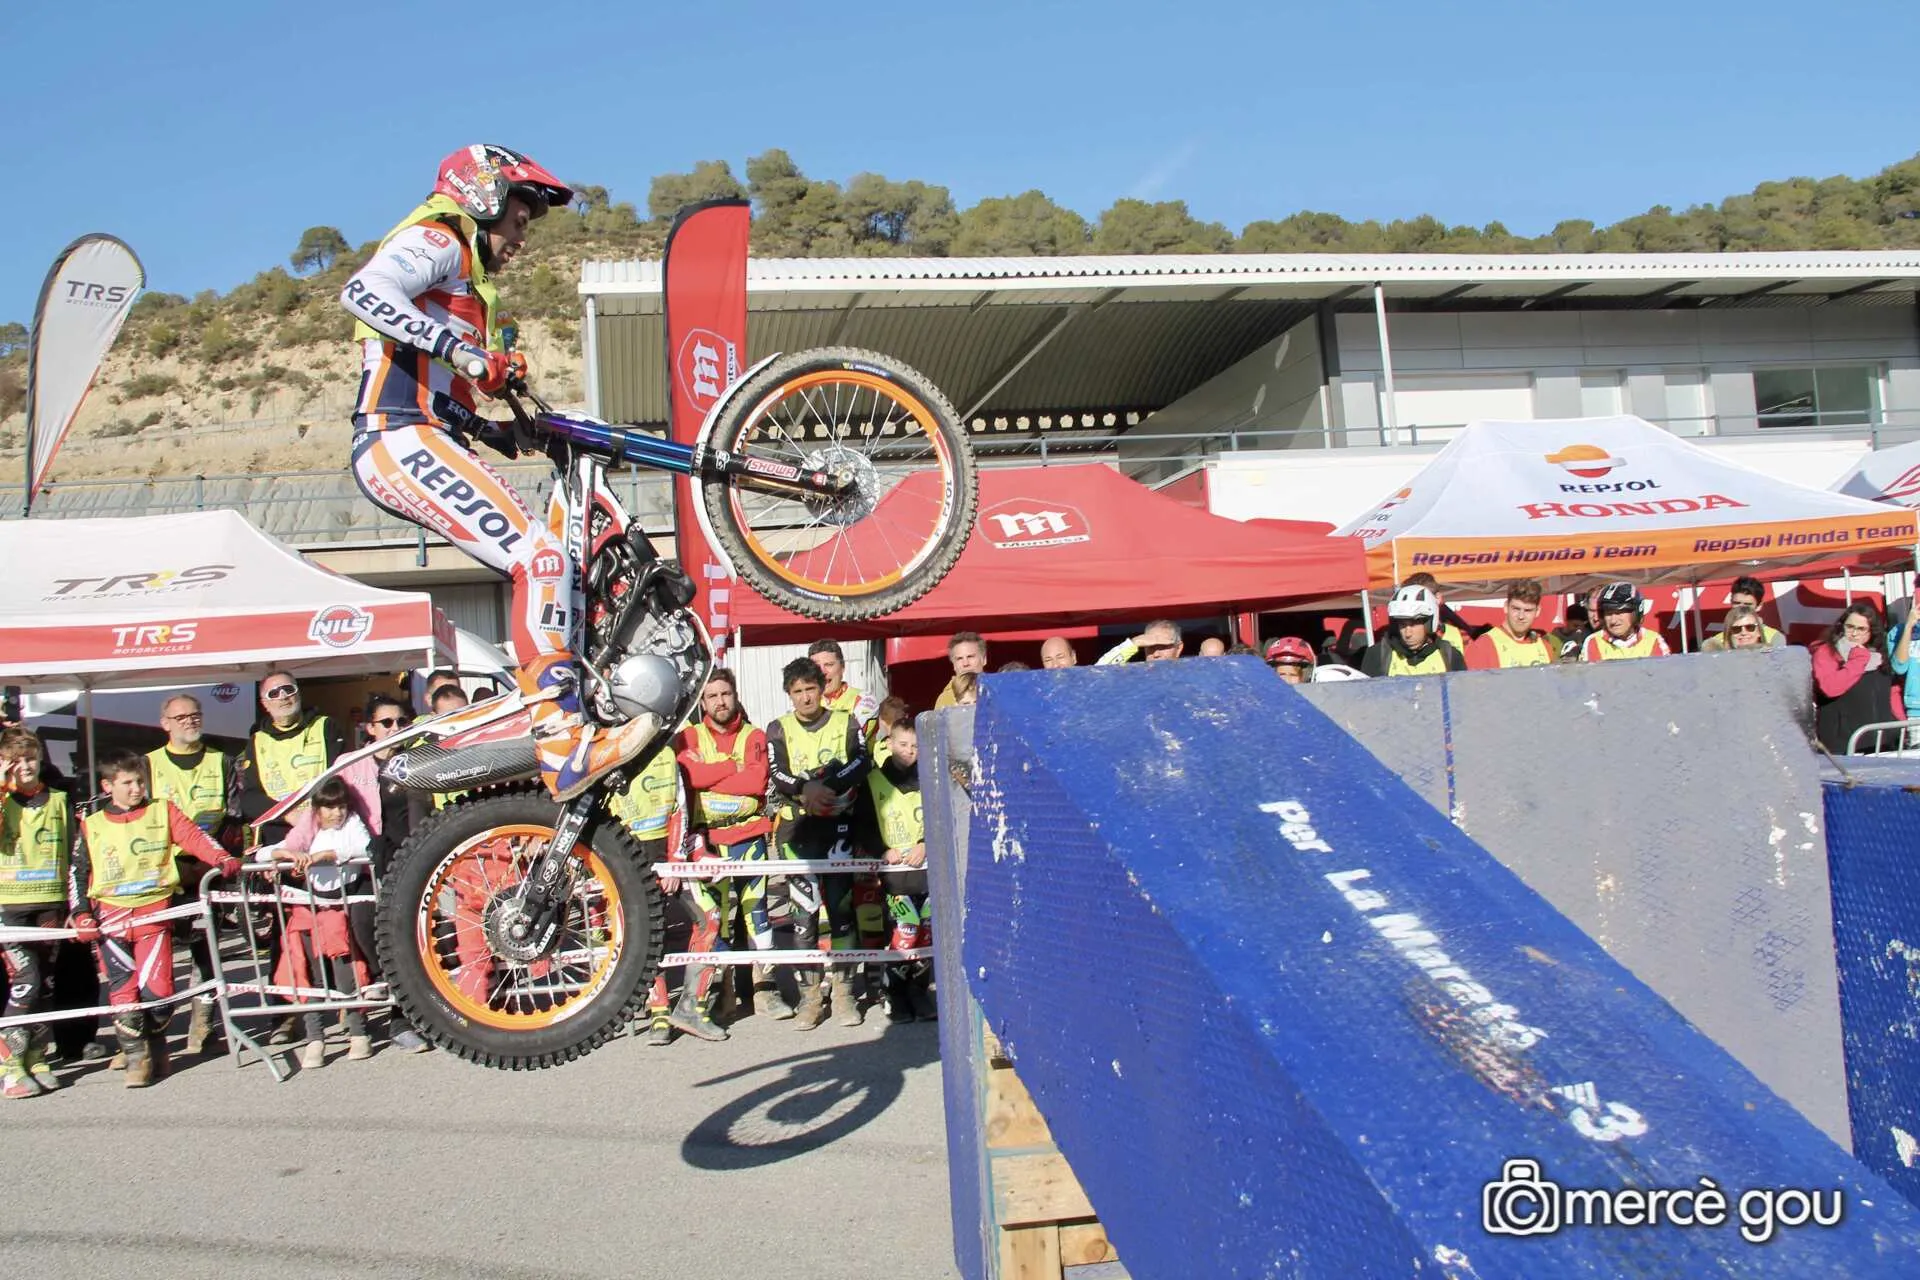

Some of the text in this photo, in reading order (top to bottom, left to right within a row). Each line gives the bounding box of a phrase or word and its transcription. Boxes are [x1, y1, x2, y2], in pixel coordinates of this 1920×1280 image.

[67, 280, 127, 303] TRS
[344, 278, 434, 341] REPSOL
[748, 459, 798, 478] SHOWA
[1559, 479, 1663, 494] REPSOL
[400, 449, 522, 553] REPSOL
[1516, 494, 1750, 520] HONDA
[1693, 524, 1915, 554] Repsol Honda Team
[1412, 544, 1657, 568] Repsol Honda Team
[41, 583, 213, 602] MOTORCYCLES
[312, 615, 369, 636] NILS
[112, 643, 193, 655] MOTORCYCLES
[211, 685, 240, 697] NILS
[435, 765, 488, 781] ShinDengen
[555, 829, 576, 854] NOK
[831, 860, 889, 872] octago
[1324, 869, 1389, 912] La
